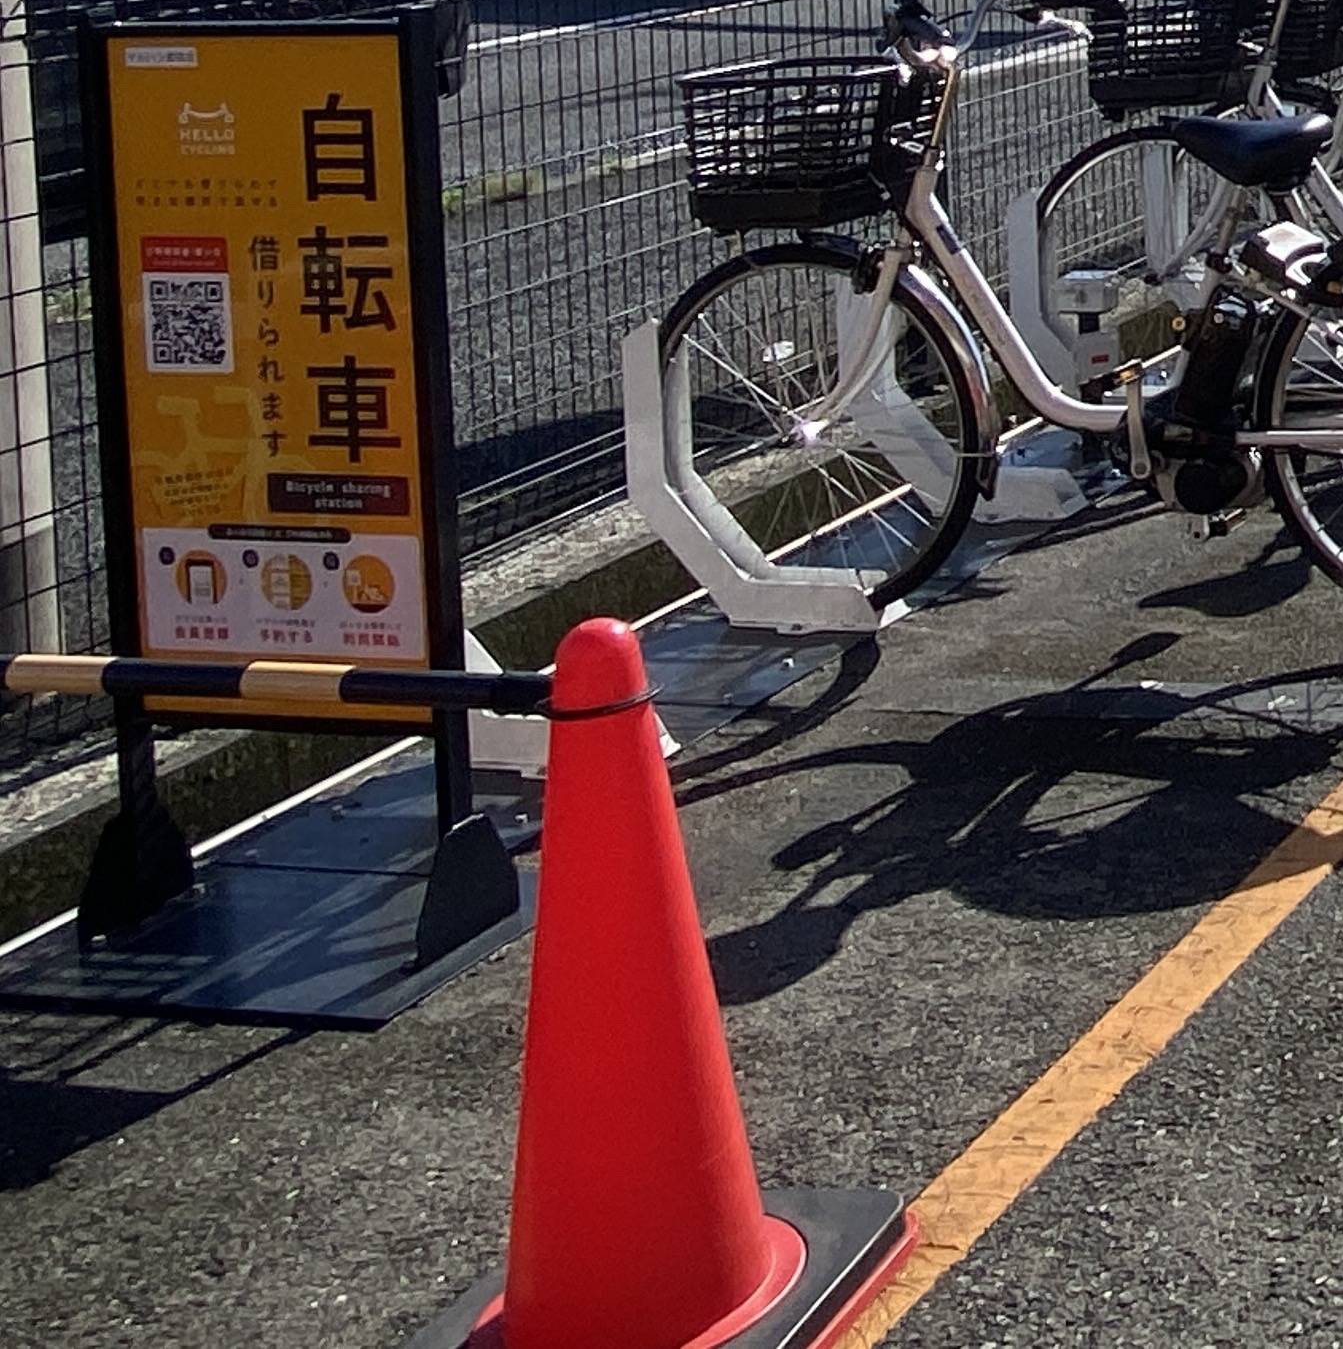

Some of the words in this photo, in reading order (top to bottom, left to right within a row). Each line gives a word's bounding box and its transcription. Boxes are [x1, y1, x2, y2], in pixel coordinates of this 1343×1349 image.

[179, 128, 235, 142] HELLO
[297, 92, 402, 463] 自転車
[248, 235, 288, 457] 借りられます
[285, 480, 334, 495] Bicycle
[342, 482, 391, 498] sharing
[314, 498, 364, 509] station
